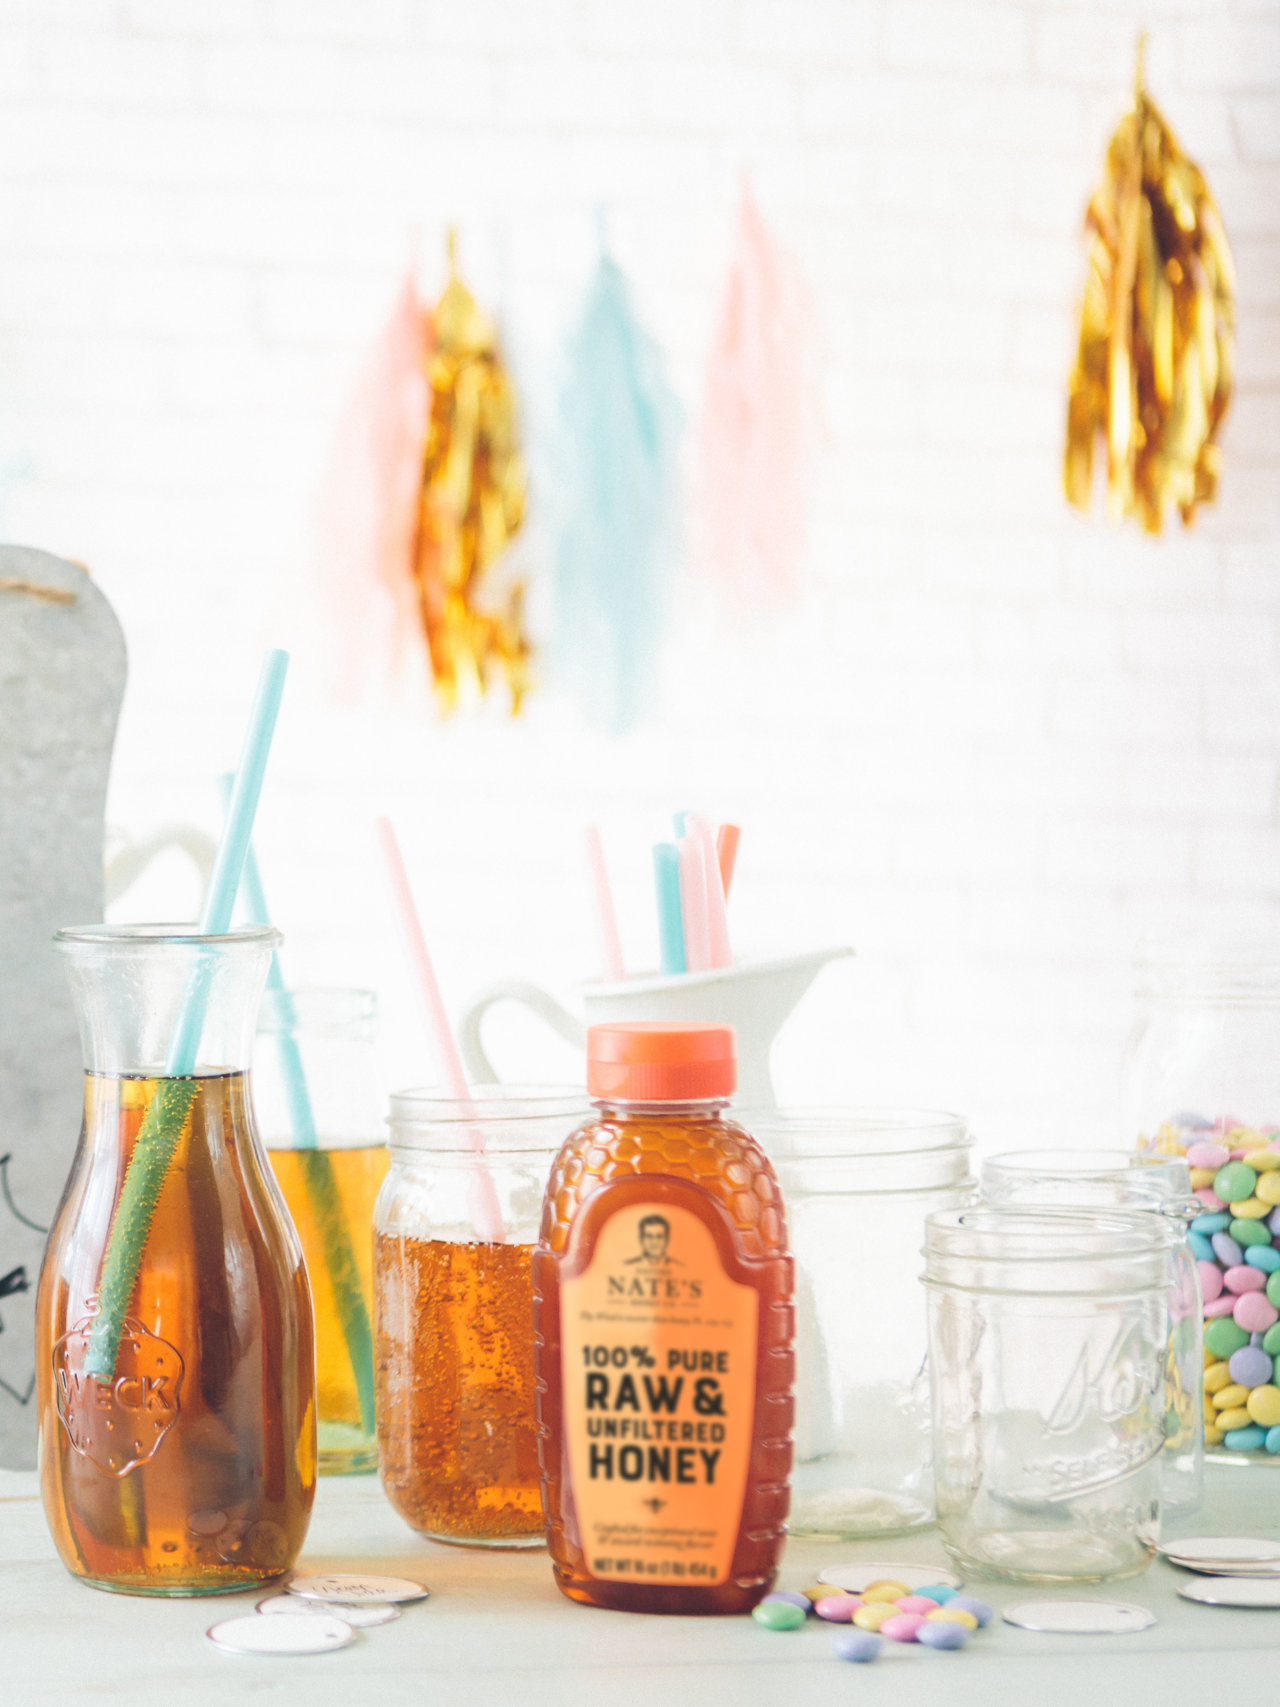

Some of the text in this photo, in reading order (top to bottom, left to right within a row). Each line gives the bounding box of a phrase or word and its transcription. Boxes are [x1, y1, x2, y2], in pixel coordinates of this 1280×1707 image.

[607, 1275, 703, 1299] NATE'S
[582, 1345, 729, 1374] 100% PURE
[585, 1372, 727, 1417] RAW &
[586, 1416, 726, 1444] UNFILTERED
[588, 1442, 723, 1486] HONEY
